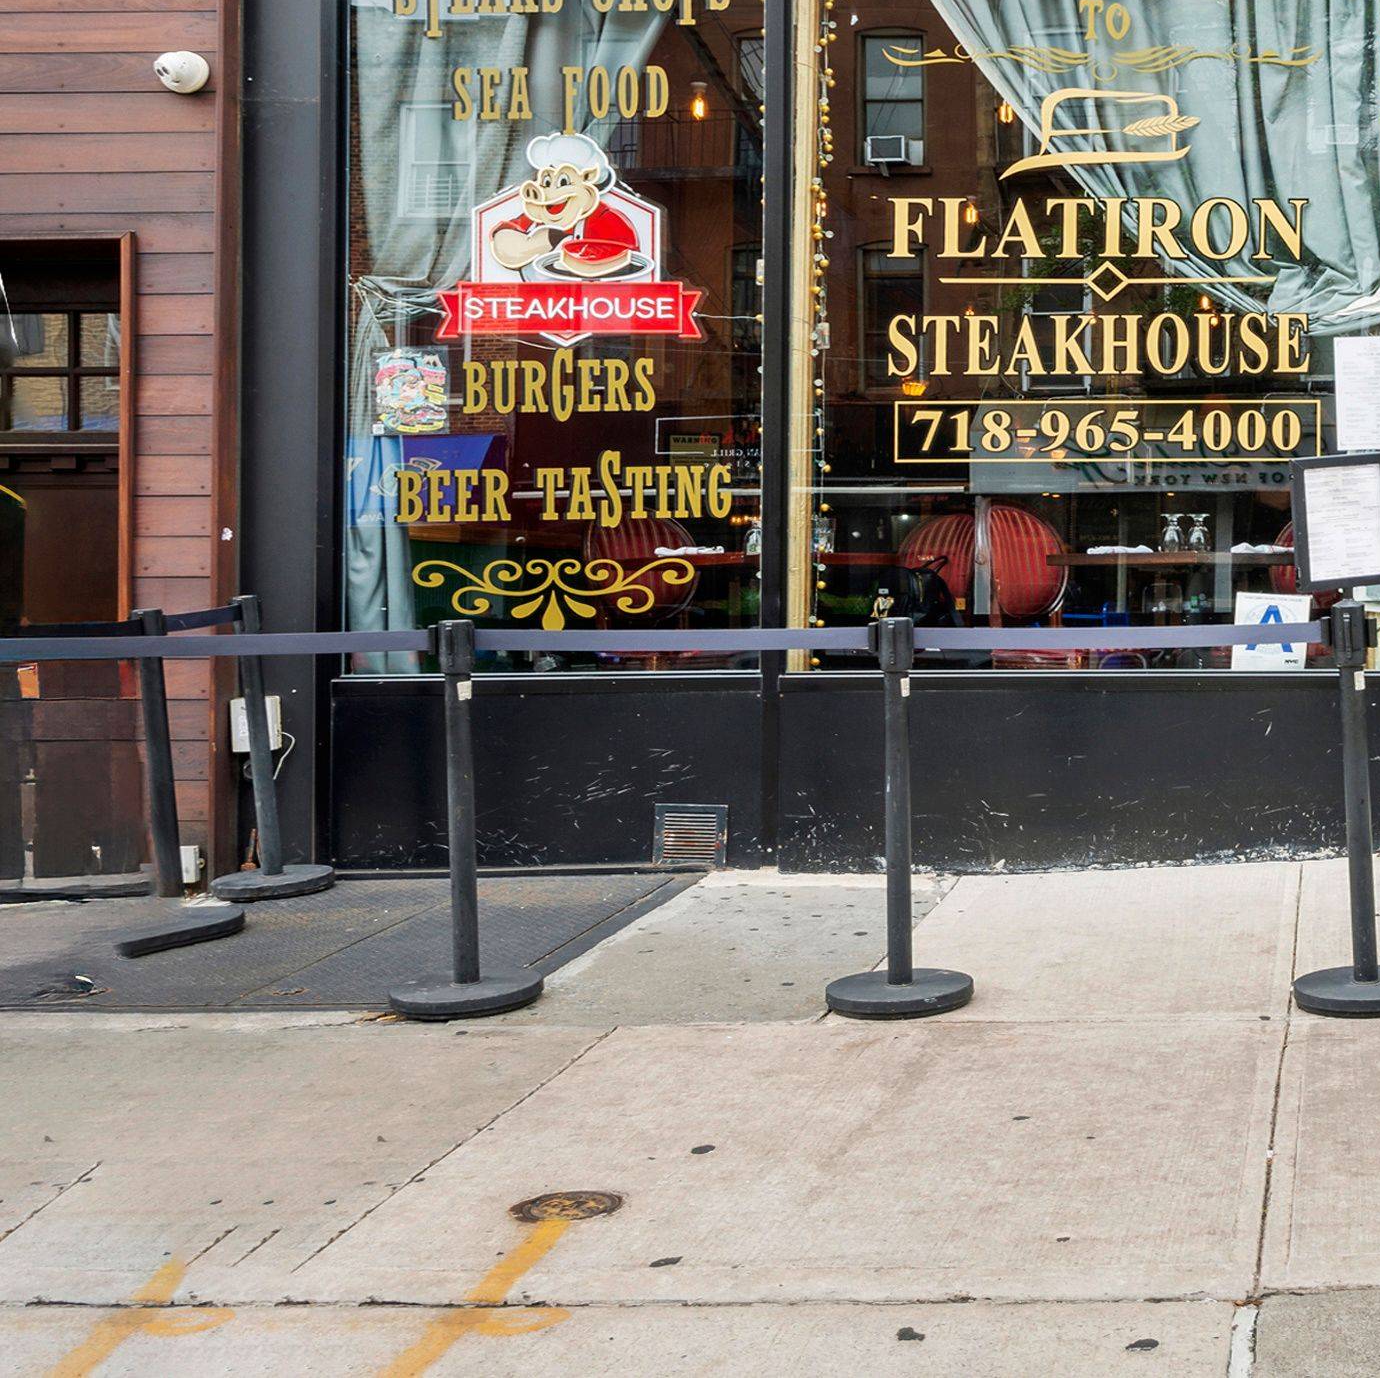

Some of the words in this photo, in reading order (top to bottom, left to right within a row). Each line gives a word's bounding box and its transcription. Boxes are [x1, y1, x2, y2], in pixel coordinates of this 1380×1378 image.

[452, 67, 533, 121] SEA
[562, 65, 670, 135] FOOD
[886, 196, 1309, 260] FLATIRON
[464, 297, 675, 320] STEAKHOUSE
[887, 312, 1310, 377] STEAKHOUSE
[463, 348, 655, 422] BURGERS
[911, 409, 1302, 453] 718-965-4000
[395, 468, 511, 523] BEER
[537, 450, 732, 528] TASTING
[1245, 605, 1294, 652] A
